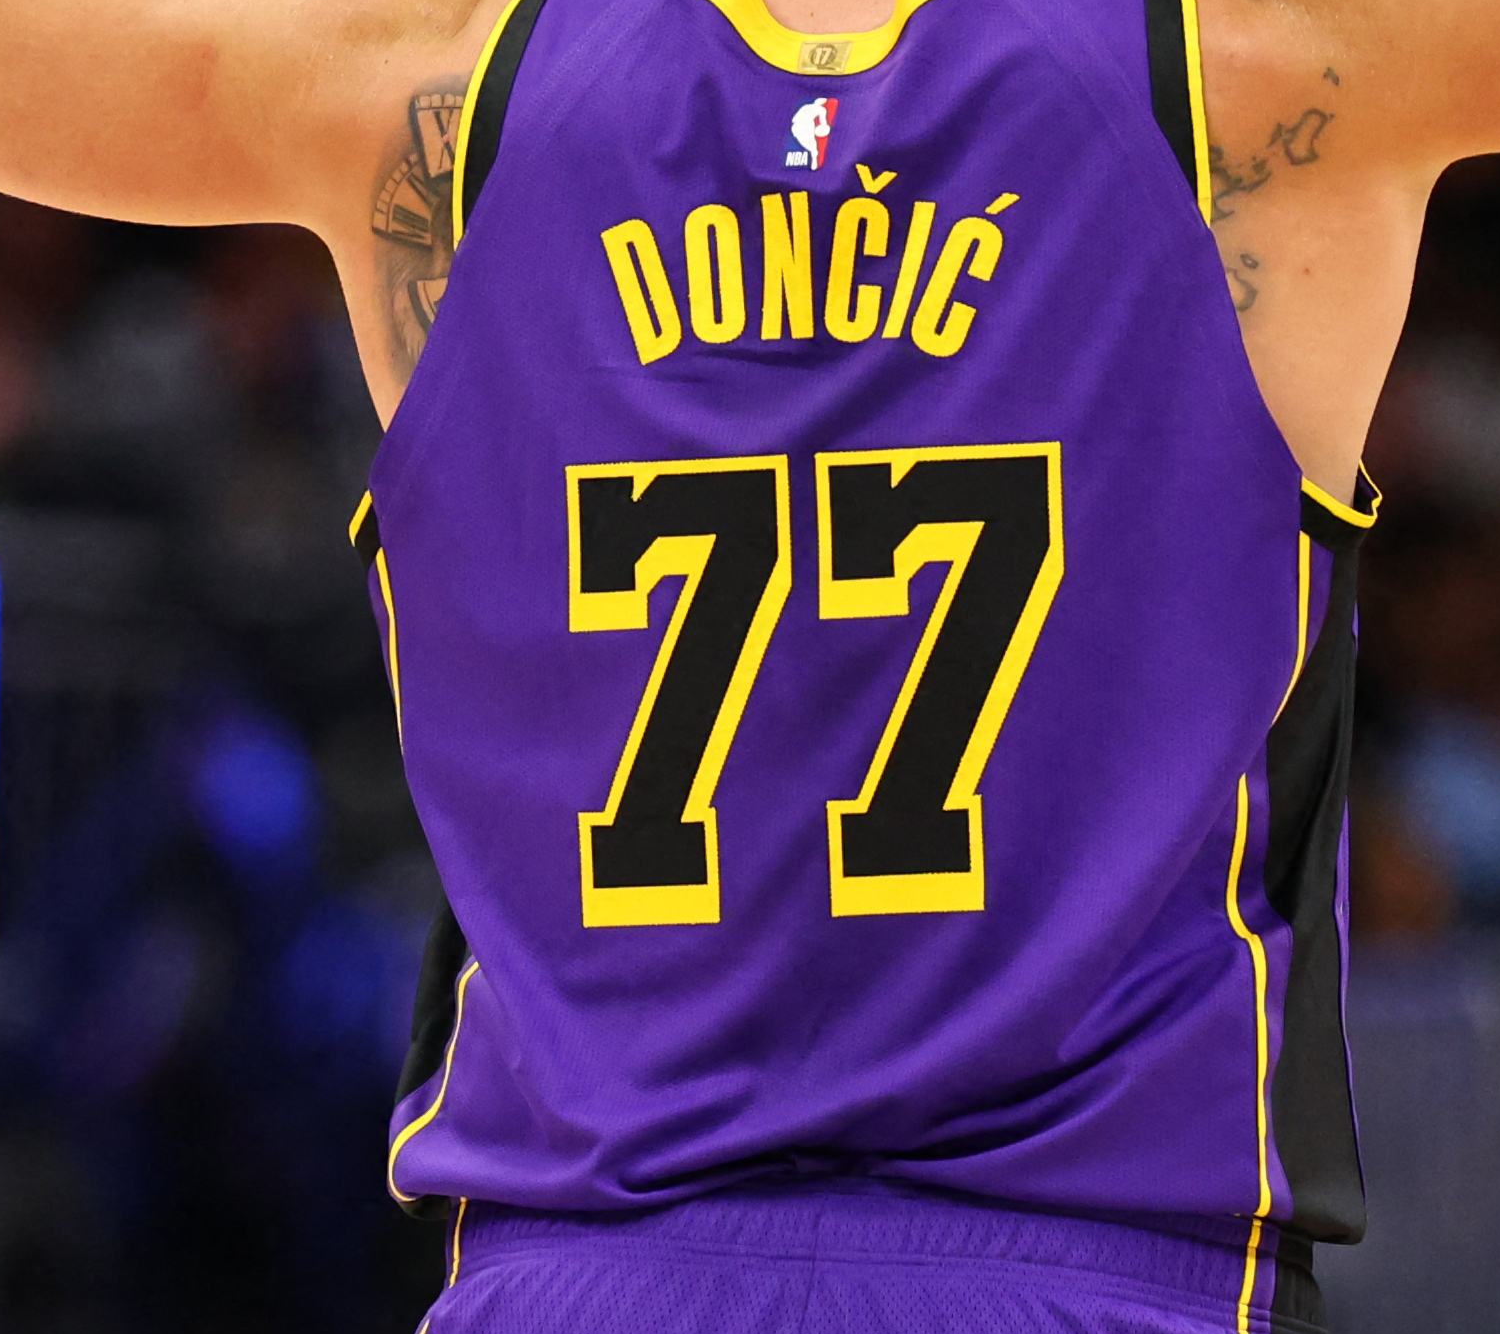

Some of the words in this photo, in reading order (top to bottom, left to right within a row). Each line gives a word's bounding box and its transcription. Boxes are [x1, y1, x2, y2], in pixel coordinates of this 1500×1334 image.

[814, 47, 832, 65] 17
[785, 151, 809, 167] NBA
[601, 164, 1020, 364] DONČIĆ
[565, 442, 1065, 927] 77
